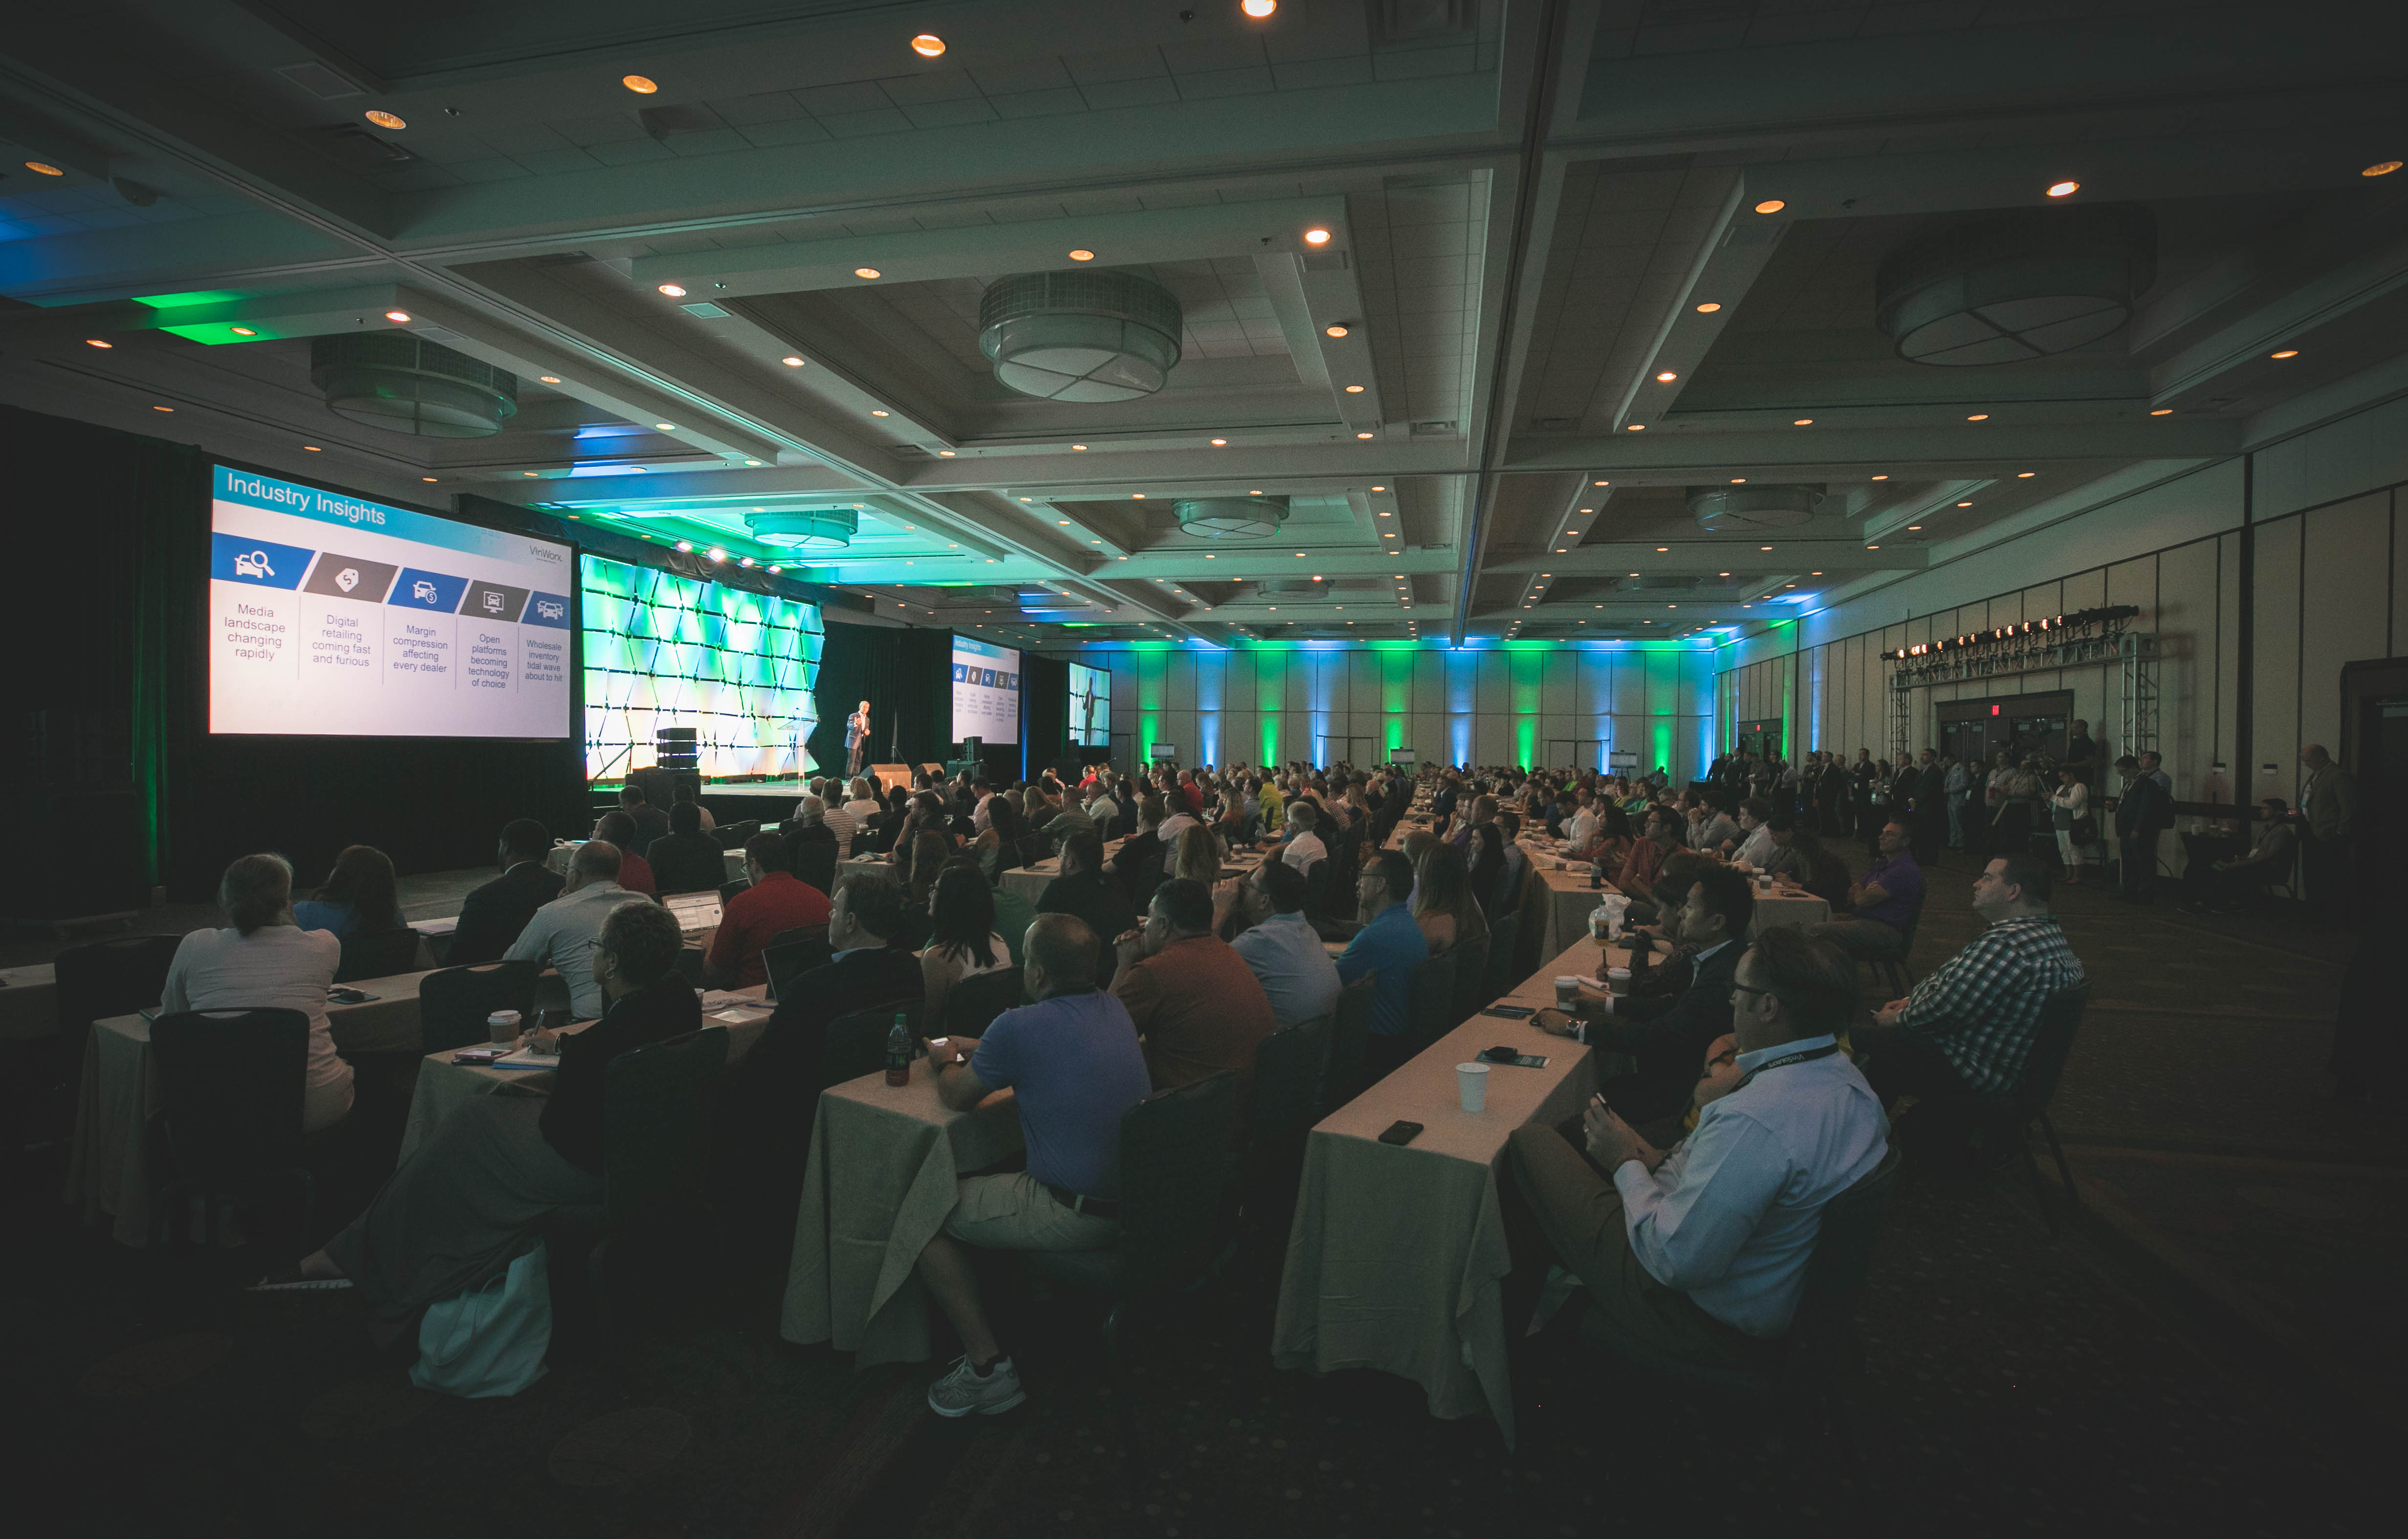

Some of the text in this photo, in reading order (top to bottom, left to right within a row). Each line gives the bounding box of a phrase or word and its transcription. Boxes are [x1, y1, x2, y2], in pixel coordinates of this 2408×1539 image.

[227, 473, 386, 525] Industry Insights
[238, 604, 274, 617] Media
[225, 616, 285, 633] landscape
[327, 615, 358, 628] Digital
[322, 628, 362, 642] retailing
[407, 624, 436, 637] Margin
[227, 632, 282, 649] changing
[393, 637, 448, 650] compression
[479, 634, 500, 644] Open
[526, 639, 562, 651] Wholesale
[236, 647, 275, 661] rapidly
[312, 641, 371, 654] coming fast
[471, 645, 507, 656] platforms
[313, 654, 370, 666] and furious
[402, 649, 439, 662] affecting
[471, 656, 508, 668] becoming
[528, 651, 560, 662] inventory
[393, 661, 447, 673] every dealer
[468, 666, 510, 680] technology
[527, 661, 561, 672] tidal wave
[471, 678, 506, 688] of choice
[525, 672, 545, 681] about
[554, 673, 563, 682] hit
